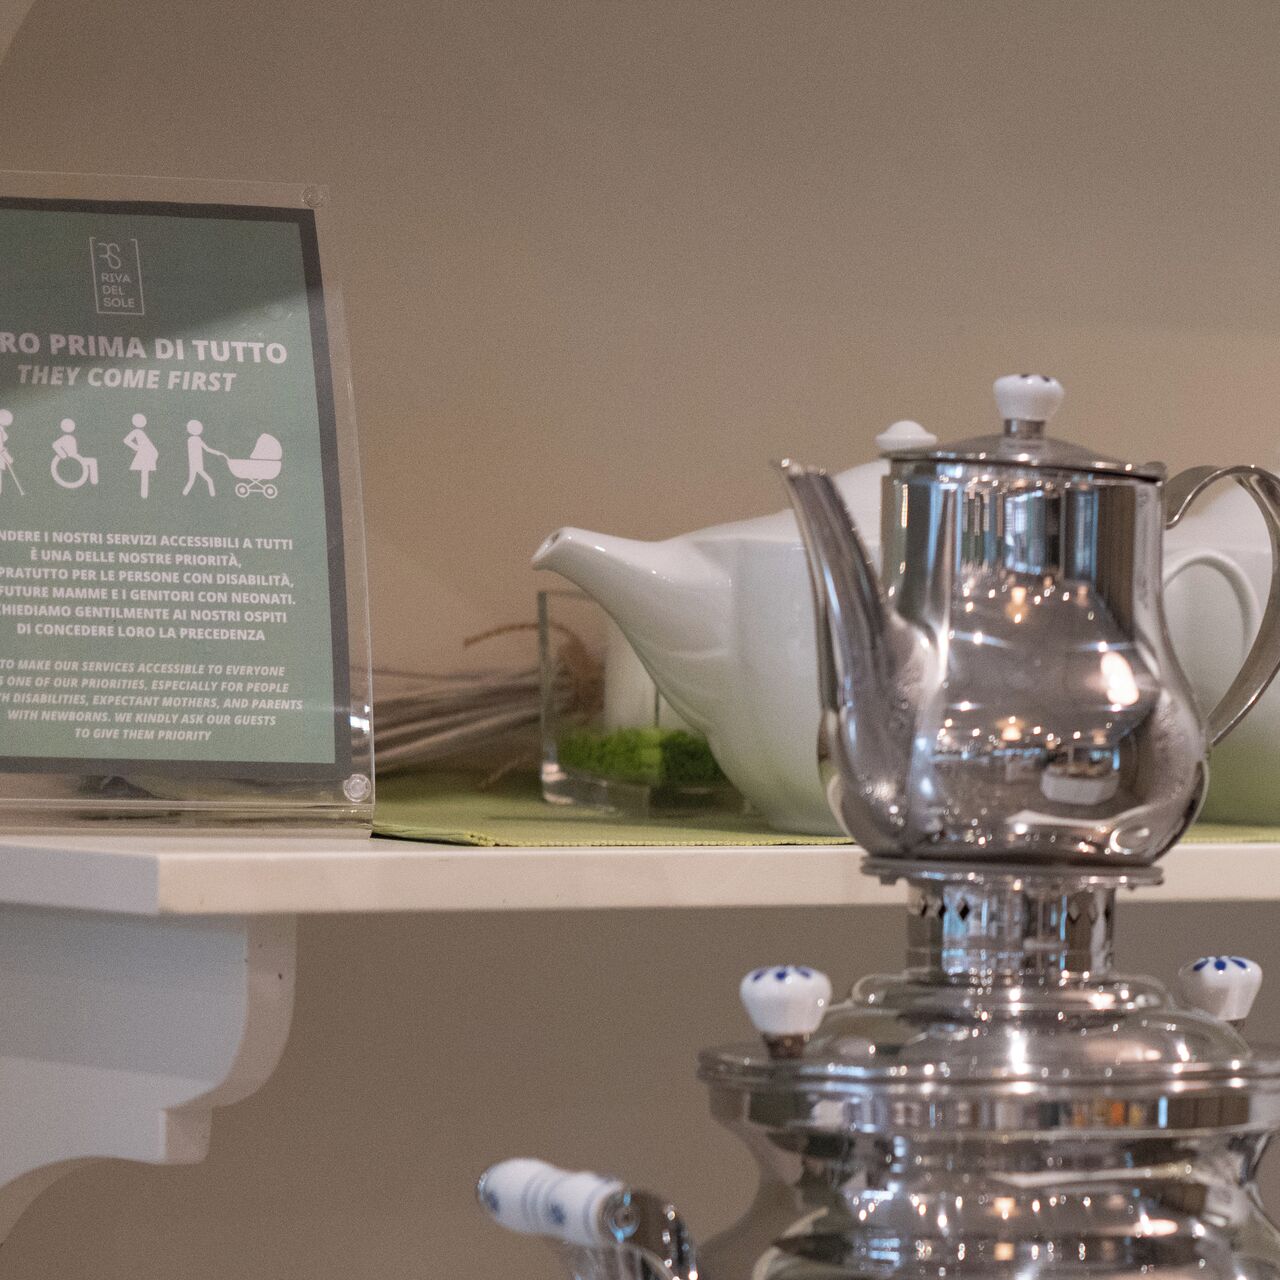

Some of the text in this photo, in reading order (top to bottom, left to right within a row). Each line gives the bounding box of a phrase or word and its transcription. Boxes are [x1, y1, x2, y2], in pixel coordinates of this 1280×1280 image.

[101, 272, 132, 283] RIVA
[102, 285, 126, 296] DEL
[103, 297, 136, 308] SOLE
[49, 333, 147, 359] PRIMA
[154, 338, 185, 360] DI
[191, 339, 288, 364] TUTTO
[18, 364, 238, 392] THEY COME FIRST
[52, 531, 103, 545] NOSTRI
[106, 533, 157, 546] SERVIZI
[160, 535, 239, 549] ACCESSIBILI
[242, 537, 253, 549] A
[255, 538, 294, 550] TUTTI
[41, 550, 72, 561] UNA
[75, 551, 115, 563] DELLE
[119, 552, 172, 565] NOSTRE
[175, 552, 242, 568] PRIORITÀ,
[72, 569, 97, 580] PER
[100, 570, 115, 581] LE
[119, 571, 180, 583] PERSONE
[183, 572, 213, 584] CON
[216, 573, 294, 588] DISABILITÀ,
[52, 587, 108, 600] MAMME
[111, 589, 119, 600] E
[130, 589, 194, 602] GENITORI
[198, 591, 228, 603] CON
[231, 592, 296, 605] NEONATI.
[0, 603, 287, 623] HIEDIAMO GENTILMENTE AI NOSTRI OSPITI
[16, 623, 266, 641] DI CONCEDERE LORO LA PRECEDENZA
[17, 660, 51, 671] MAKE
[54, 661, 79, 672] OUR
[81, 661, 135, 673] SERVICES
[137, 663, 206, 674] ACCESSIBLE
[207, 664, 223, 674] TO
[225, 665, 286, 676] EVERYONE
[7, 676, 31, 687] ONE
[34, 677, 51, 687] OF
[53, 678, 79, 688] OUR
[151, 680, 218, 691] ESPECIALLY
[220, 681, 244, 692] FOR
[246, 682, 290, 693] PEOPLE
[13, 693, 89, 706] DISABILITIES,
[92, 695, 160, 706] EXPECTANT
[162, 697, 220, 709] MOTHERS,
[223, 698, 249, 709] AND
[251, 699, 304, 710] PARENTS
[8, 709, 277, 726] WITH NEWBORNS. WE KINDLY ASK OUR GUESTS
[75, 728, 212, 741] TO GIVE THEM PRIORITY
